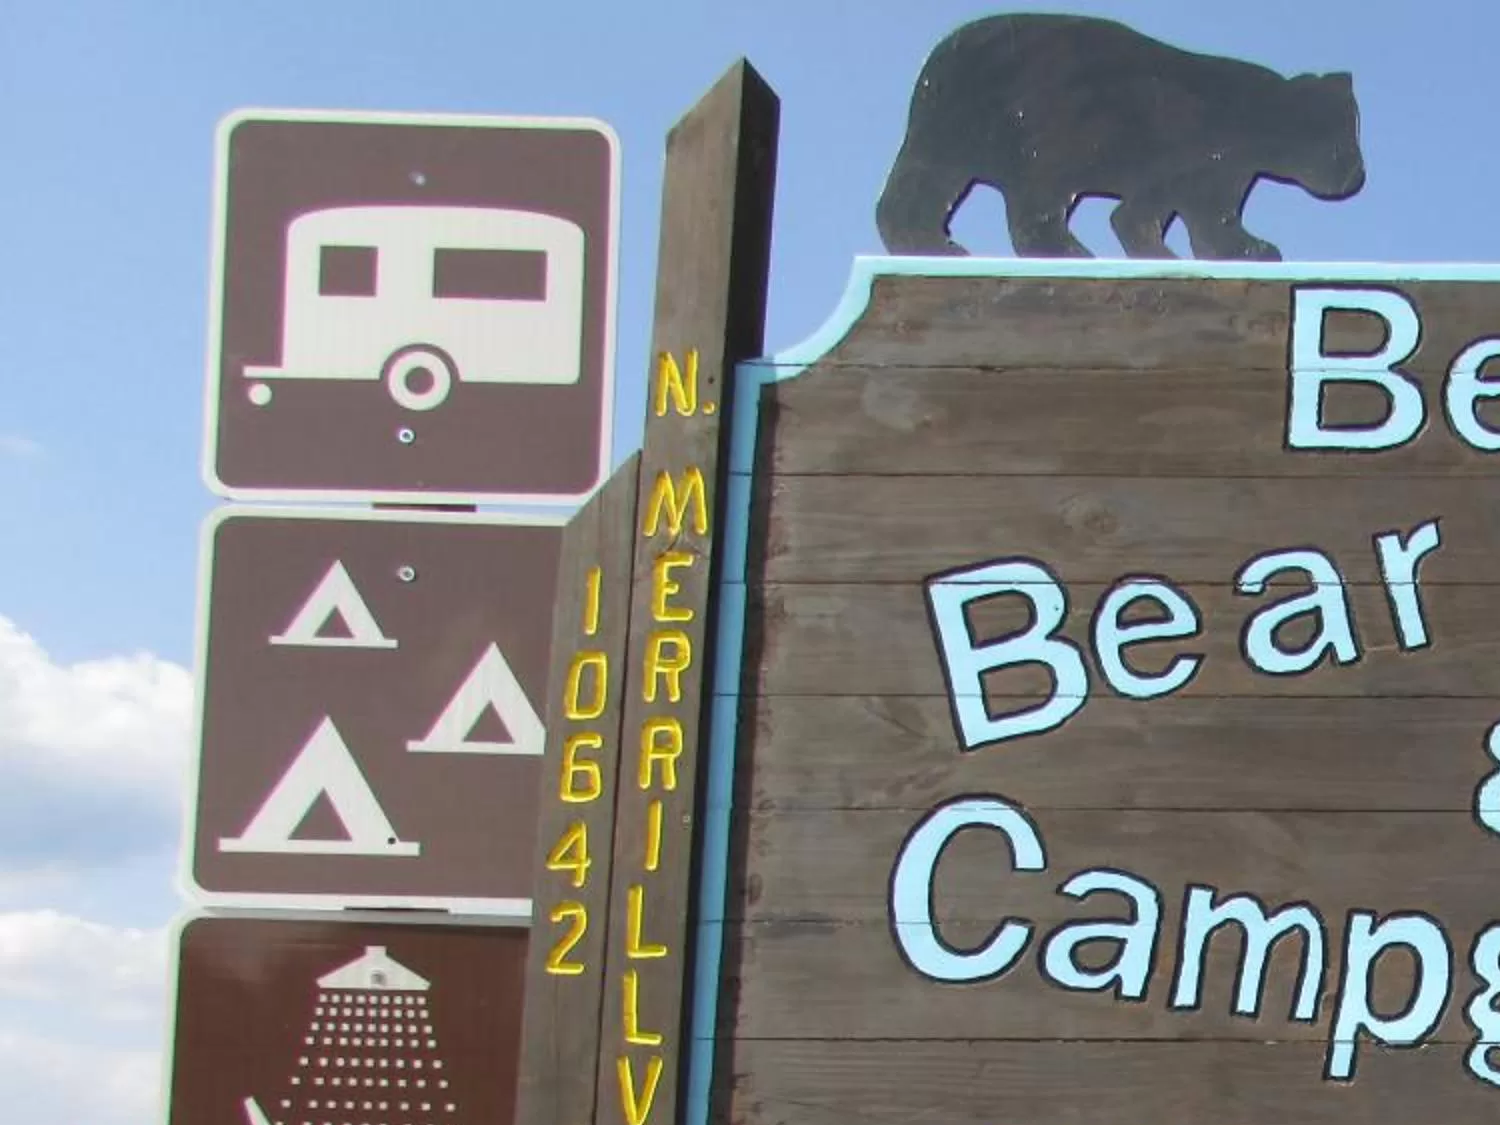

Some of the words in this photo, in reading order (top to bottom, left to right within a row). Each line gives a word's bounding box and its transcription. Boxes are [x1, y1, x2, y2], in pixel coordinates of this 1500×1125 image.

[653, 347, 718, 418] N.
[925, 522, 1444, 753] Bear
[542, 566, 612, 979] 10642
